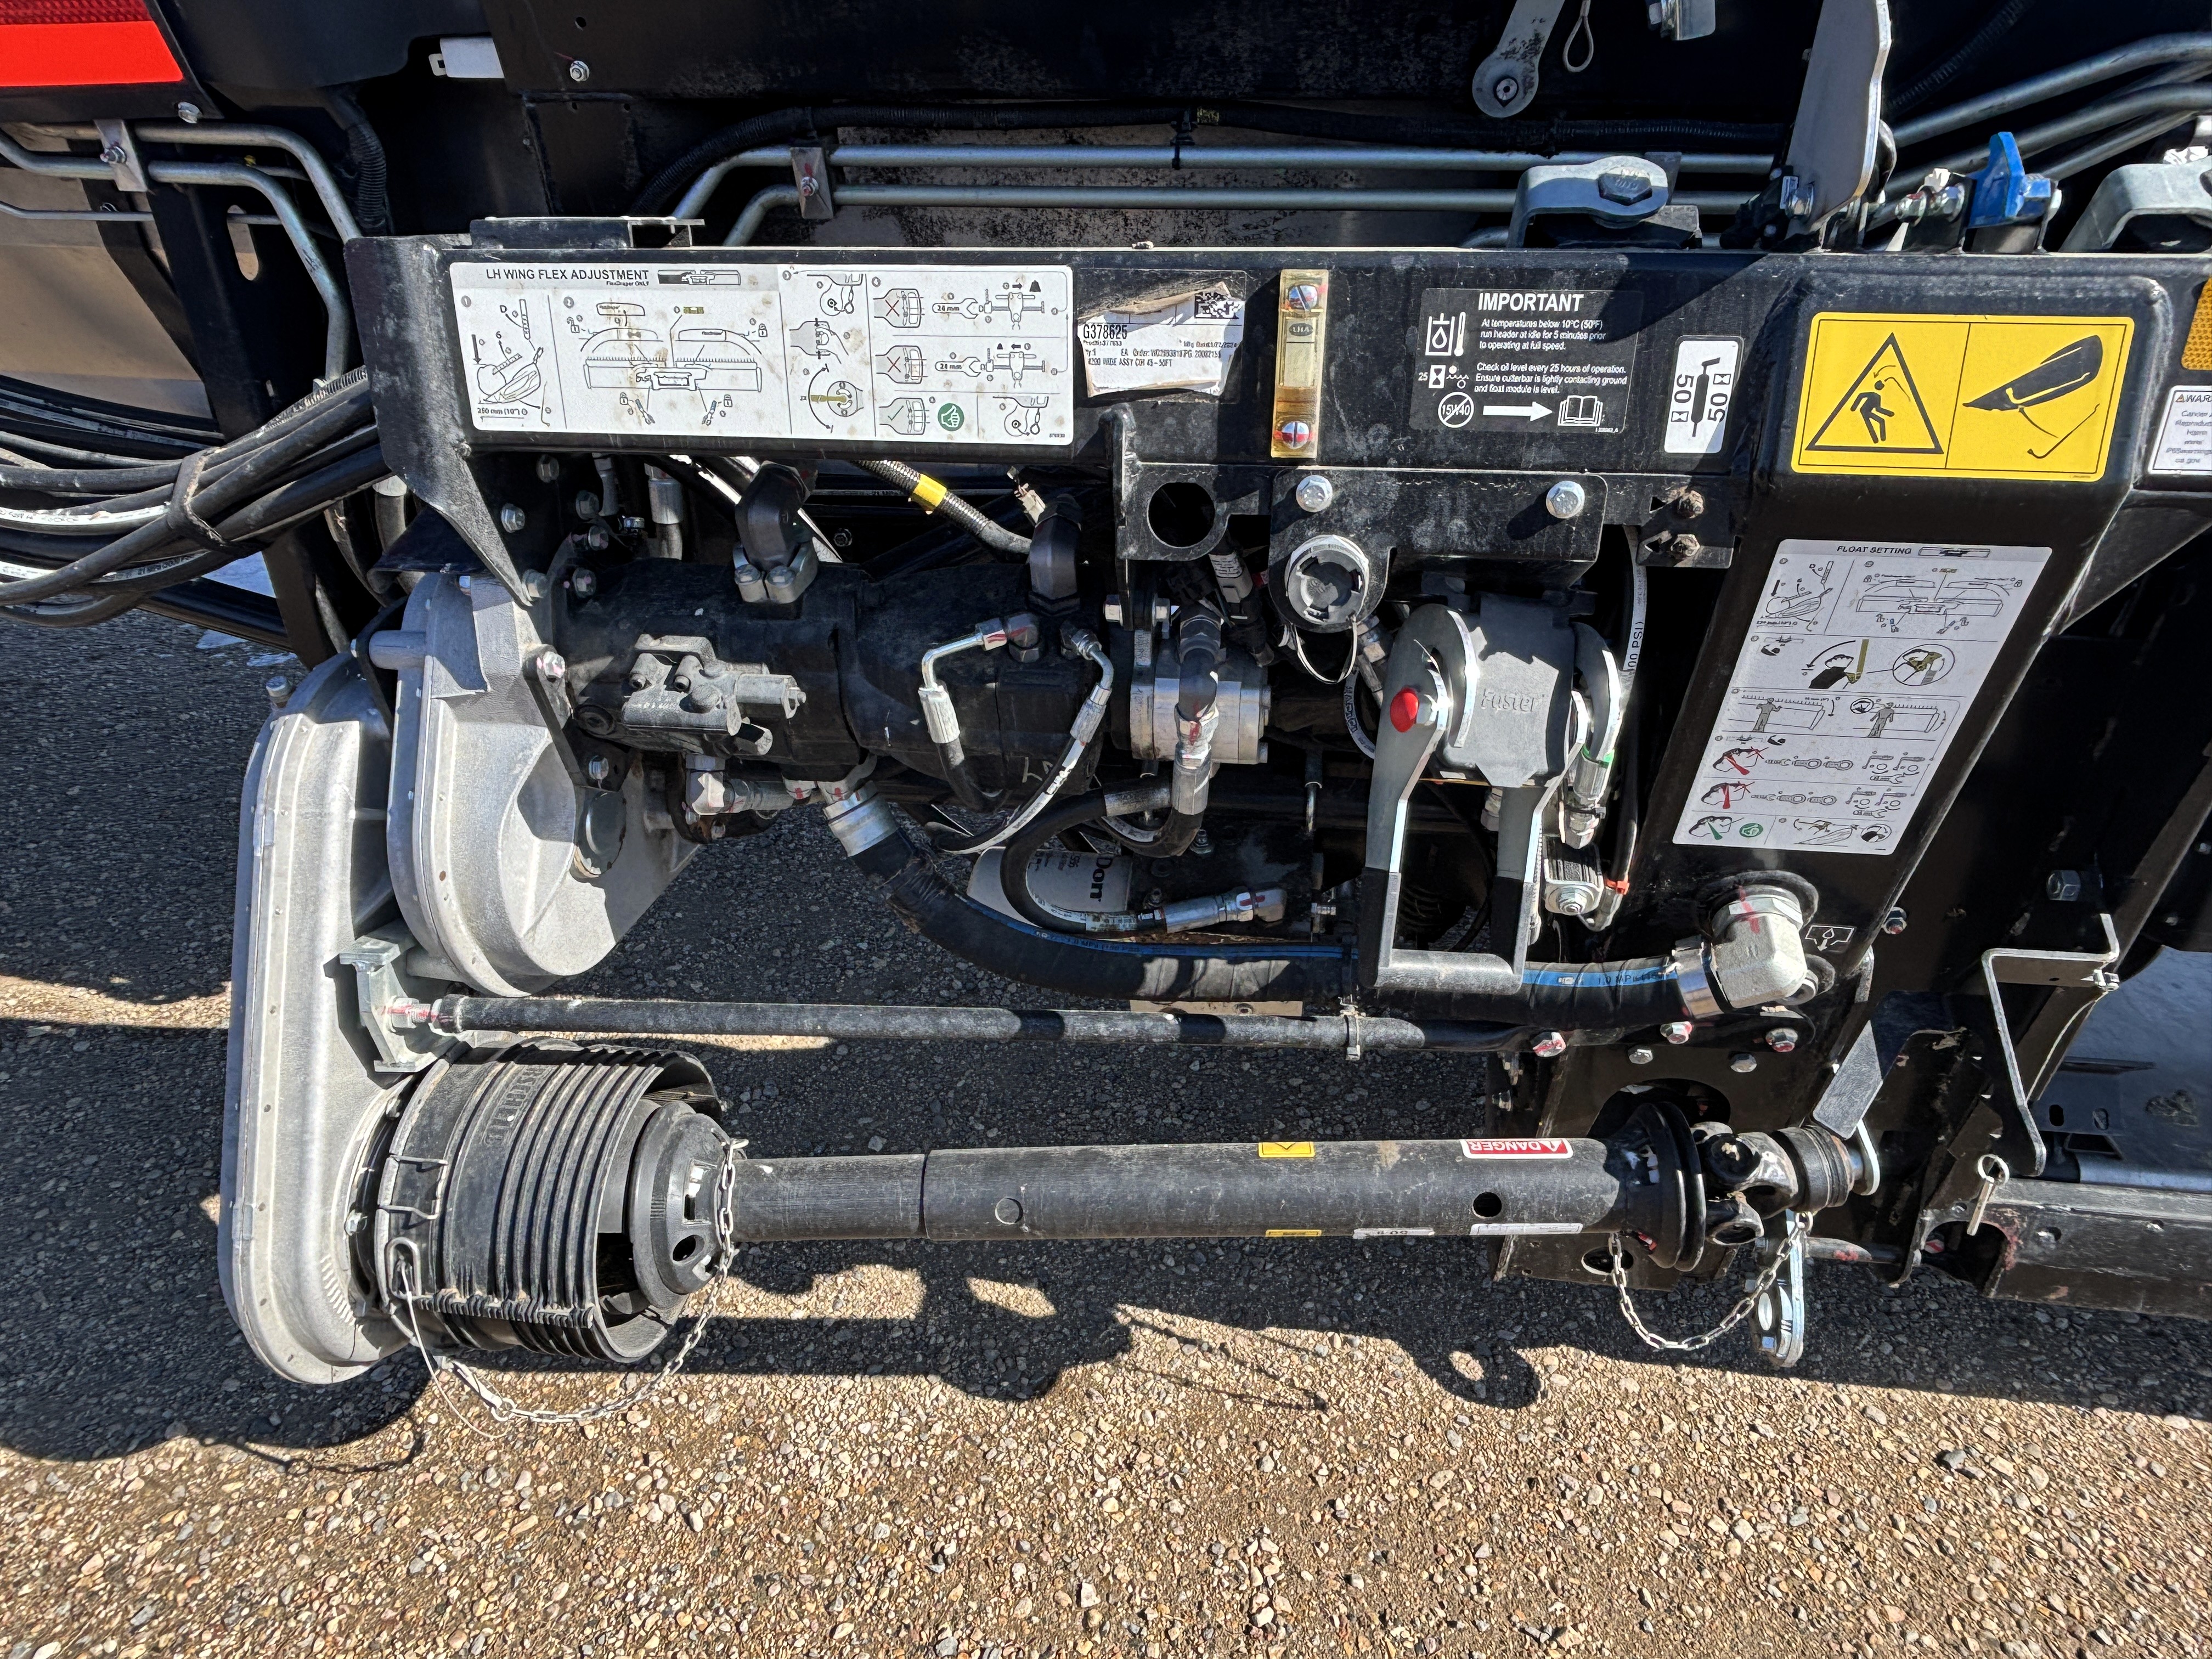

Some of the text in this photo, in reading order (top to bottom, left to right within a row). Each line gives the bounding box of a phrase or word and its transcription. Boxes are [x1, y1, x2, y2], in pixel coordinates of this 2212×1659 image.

[486, 269, 649, 280] LH WING FLEX ADJUSTMENT
[1478, 292, 1584, 312] IMPORTANT
[1491, 319, 1537, 329] temperatures
[1538, 319, 1560, 328] below
[1083, 324, 1127, 340] G378625
[1528, 330, 1541, 338] idle
[1542, 330, 1553, 338] for
[1560, 331, 1588, 340] minutes
[1589, 331, 1606, 341] prior
[1479, 341, 1487, 349] to
[1488, 341, 1520, 351] operating
[1522, 341, 1529, 349] at
[1530, 341, 1541, 349] full
[1476, 362, 1499, 371] Check
[1510, 363, 1527, 371] level
[1528, 364, 1549, 374] every
[1549, 364, 1560, 372] 25
[1561, 364, 1581, 373] hours
[1582, 364, 1591, 373] of
[1592, 365, 1626, 375] operation.
[1418, 372, 1428, 381] 25
[1476, 374, 1500, 382] Ensure
[1564, 375, 1600, 386] contacting
[1601, 376, 1628, 386] ground
[1505, 385, 1532, 393] module
[1674, 374, 1695, 403] 50
[1707, 393, 1728, 421] 50
[1870, 546, 1912, 555] SETTING
[1626, 653, 1639, 672] 00
[1469, 1141, 1542, 1151] DANGER
